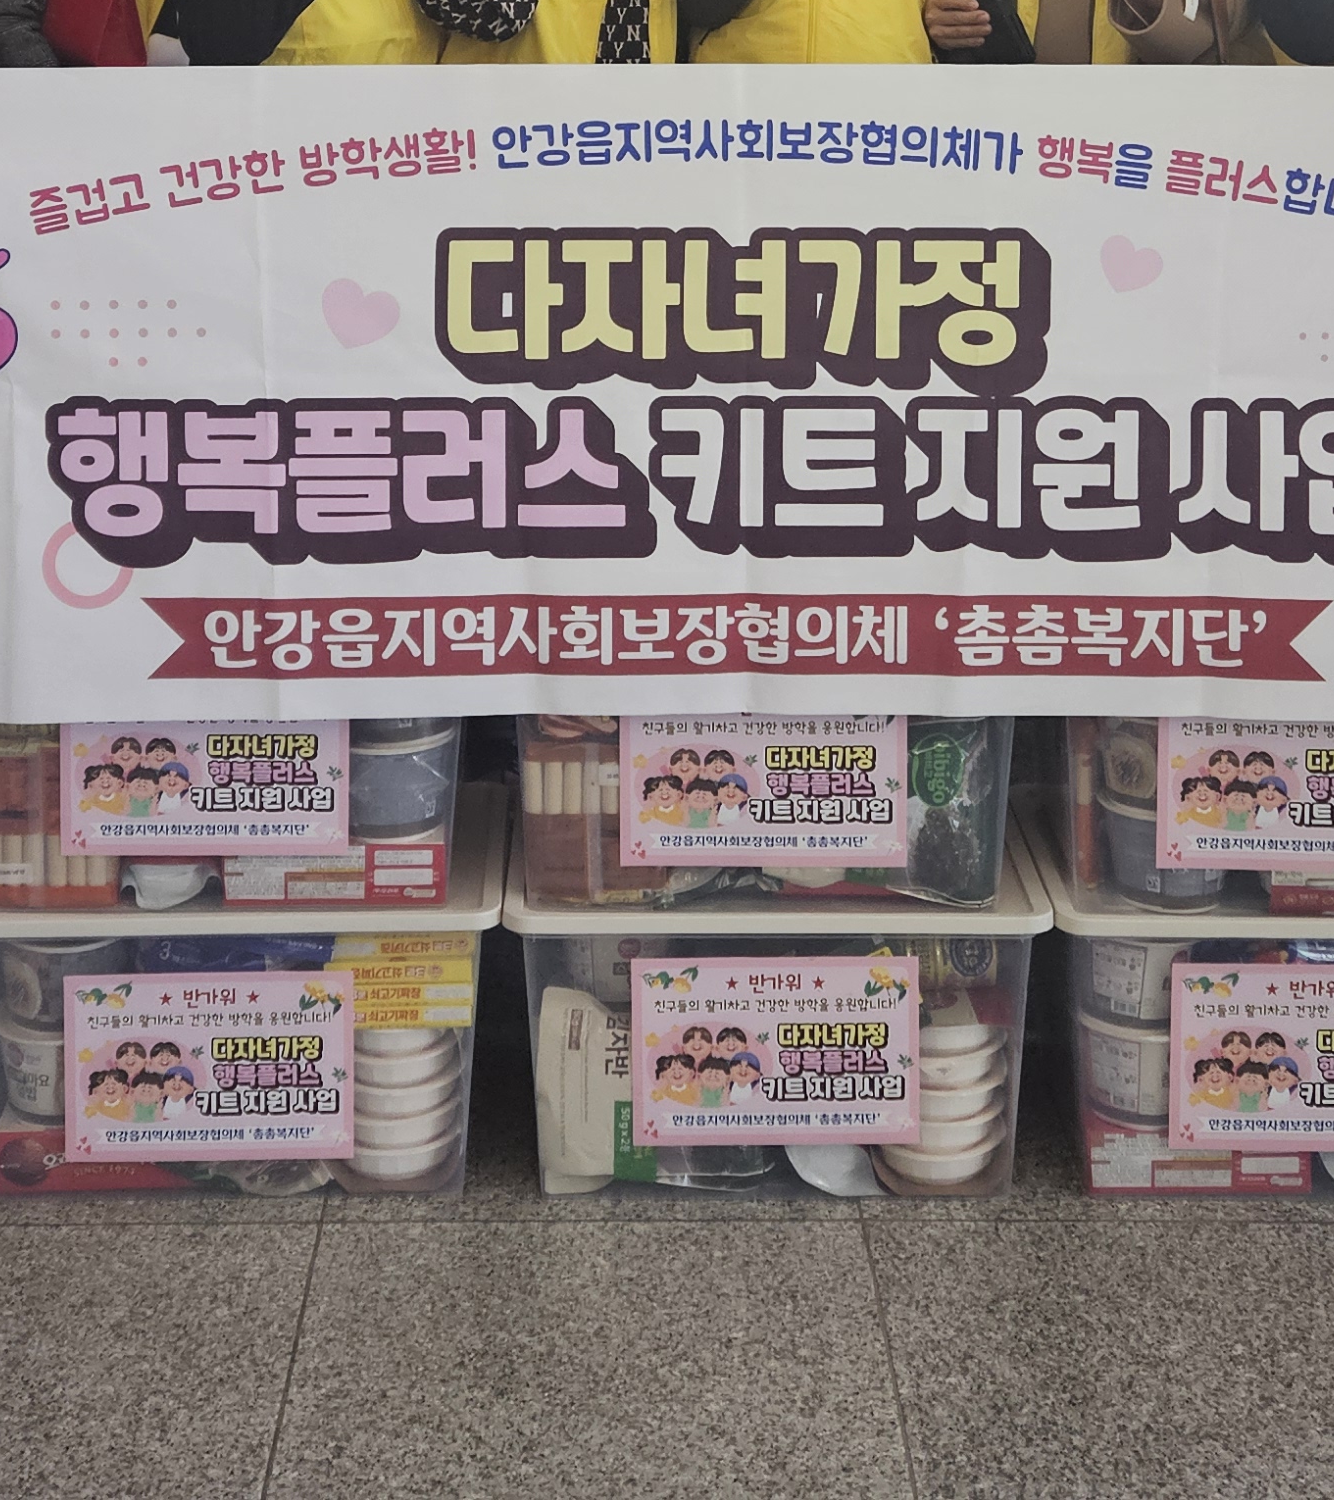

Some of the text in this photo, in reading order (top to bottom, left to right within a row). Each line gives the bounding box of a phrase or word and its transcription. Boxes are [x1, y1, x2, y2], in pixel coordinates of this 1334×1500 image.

[28, 174, 150, 235] 즐겁고
[161, 149, 285, 210] 건강한
[300, 128, 477, 188] 방학생활!
[492, 118, 1023, 175] 안강읍지역사회보장협의체가
[1038, 134, 1155, 190] 행복을
[448, 238, 1022, 368] 다자녀가정
[59, 407, 628, 538] 행복플러스
[661, 407, 883, 529] 키트
[917, 406, 1143, 532] 지원
[203, 605, 909, 672] 안강읍지역사회보장협의체
[643, 721, 884, 736] 친구들의 활기차고 건강한 방학을 응원합니다!
[1181, 721, 1227, 736] 친구들의
[1232, 722, 1279, 737] 활기차고
[1284, 723, 1319, 739] 건강한
[207, 734, 317, 759] 다자녀가정
[765, 745, 875, 771] 다자녀가정
[208, 760, 318, 784] 행복플러스
[766, 772, 876, 796] 행복플러스
[191, 787, 334, 811] 키트 지원 사업
[750, 799, 892, 823] 키트 지원 사업
[1289, 802, 1334, 827] 키트
[370, 988, 421, 1000] 쇠고기짜장
[748, 974, 801, 994] 반가워
[182, 989, 235, 1009] 반가워
[654, 998, 897, 1013] 친구들의 활기차고 건강한 방학을 응원합니다!
[1194, 1004, 1239, 1018] 친구들의
[1244, 1003, 1291, 1018] 활기차고
[1296, 1004, 1329, 1019] 건강한
[87, 1011, 331, 1029] 친구들의 활기차고 건강한 방학을 응원합니다!
[369, 1010, 419, 1022] 쇠고기짜장
[605, 1016, 629, 1079] 김자반
[778, 1023, 887, 1048] 다자녀가정
[212, 1036, 322, 1062] 다자녀가정
[779, 1050, 888, 1073] 행복플러스
[213, 1063, 323, 1087] 행복플러스
[763, 1076, 904, 1100] 키트 지원 사업
[196, 1089, 339, 1115] 키트 지원 사업
